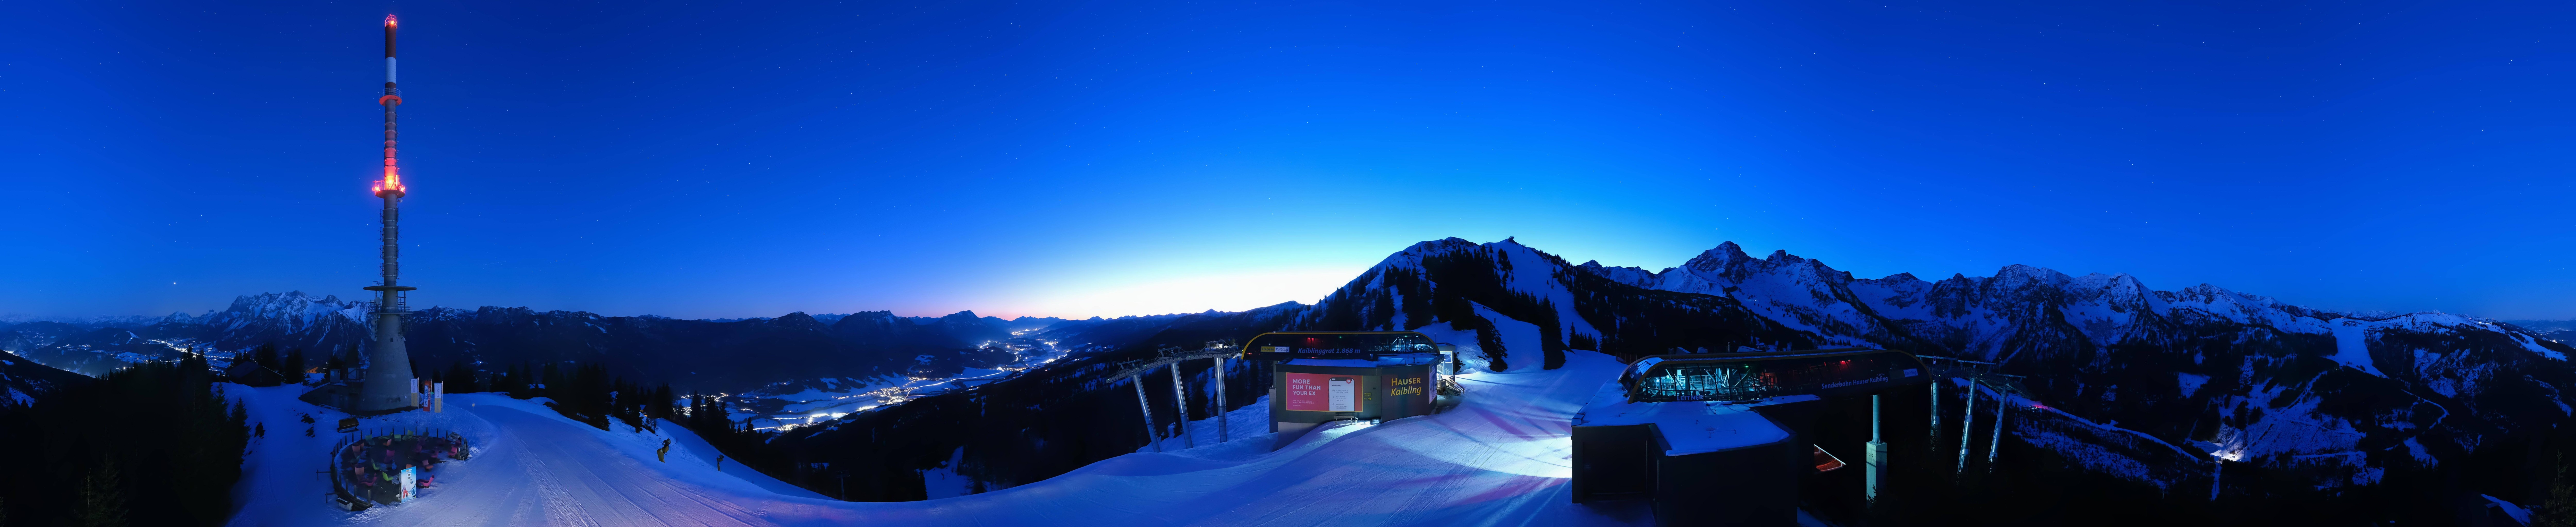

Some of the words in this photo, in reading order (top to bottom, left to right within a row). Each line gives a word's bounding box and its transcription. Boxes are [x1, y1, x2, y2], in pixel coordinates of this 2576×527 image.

[1391, 377, 1421, 386] HAUSER
[1821, 380, 1852, 389] Senderbahn
[1391, 386, 1421, 396] Kaibling
